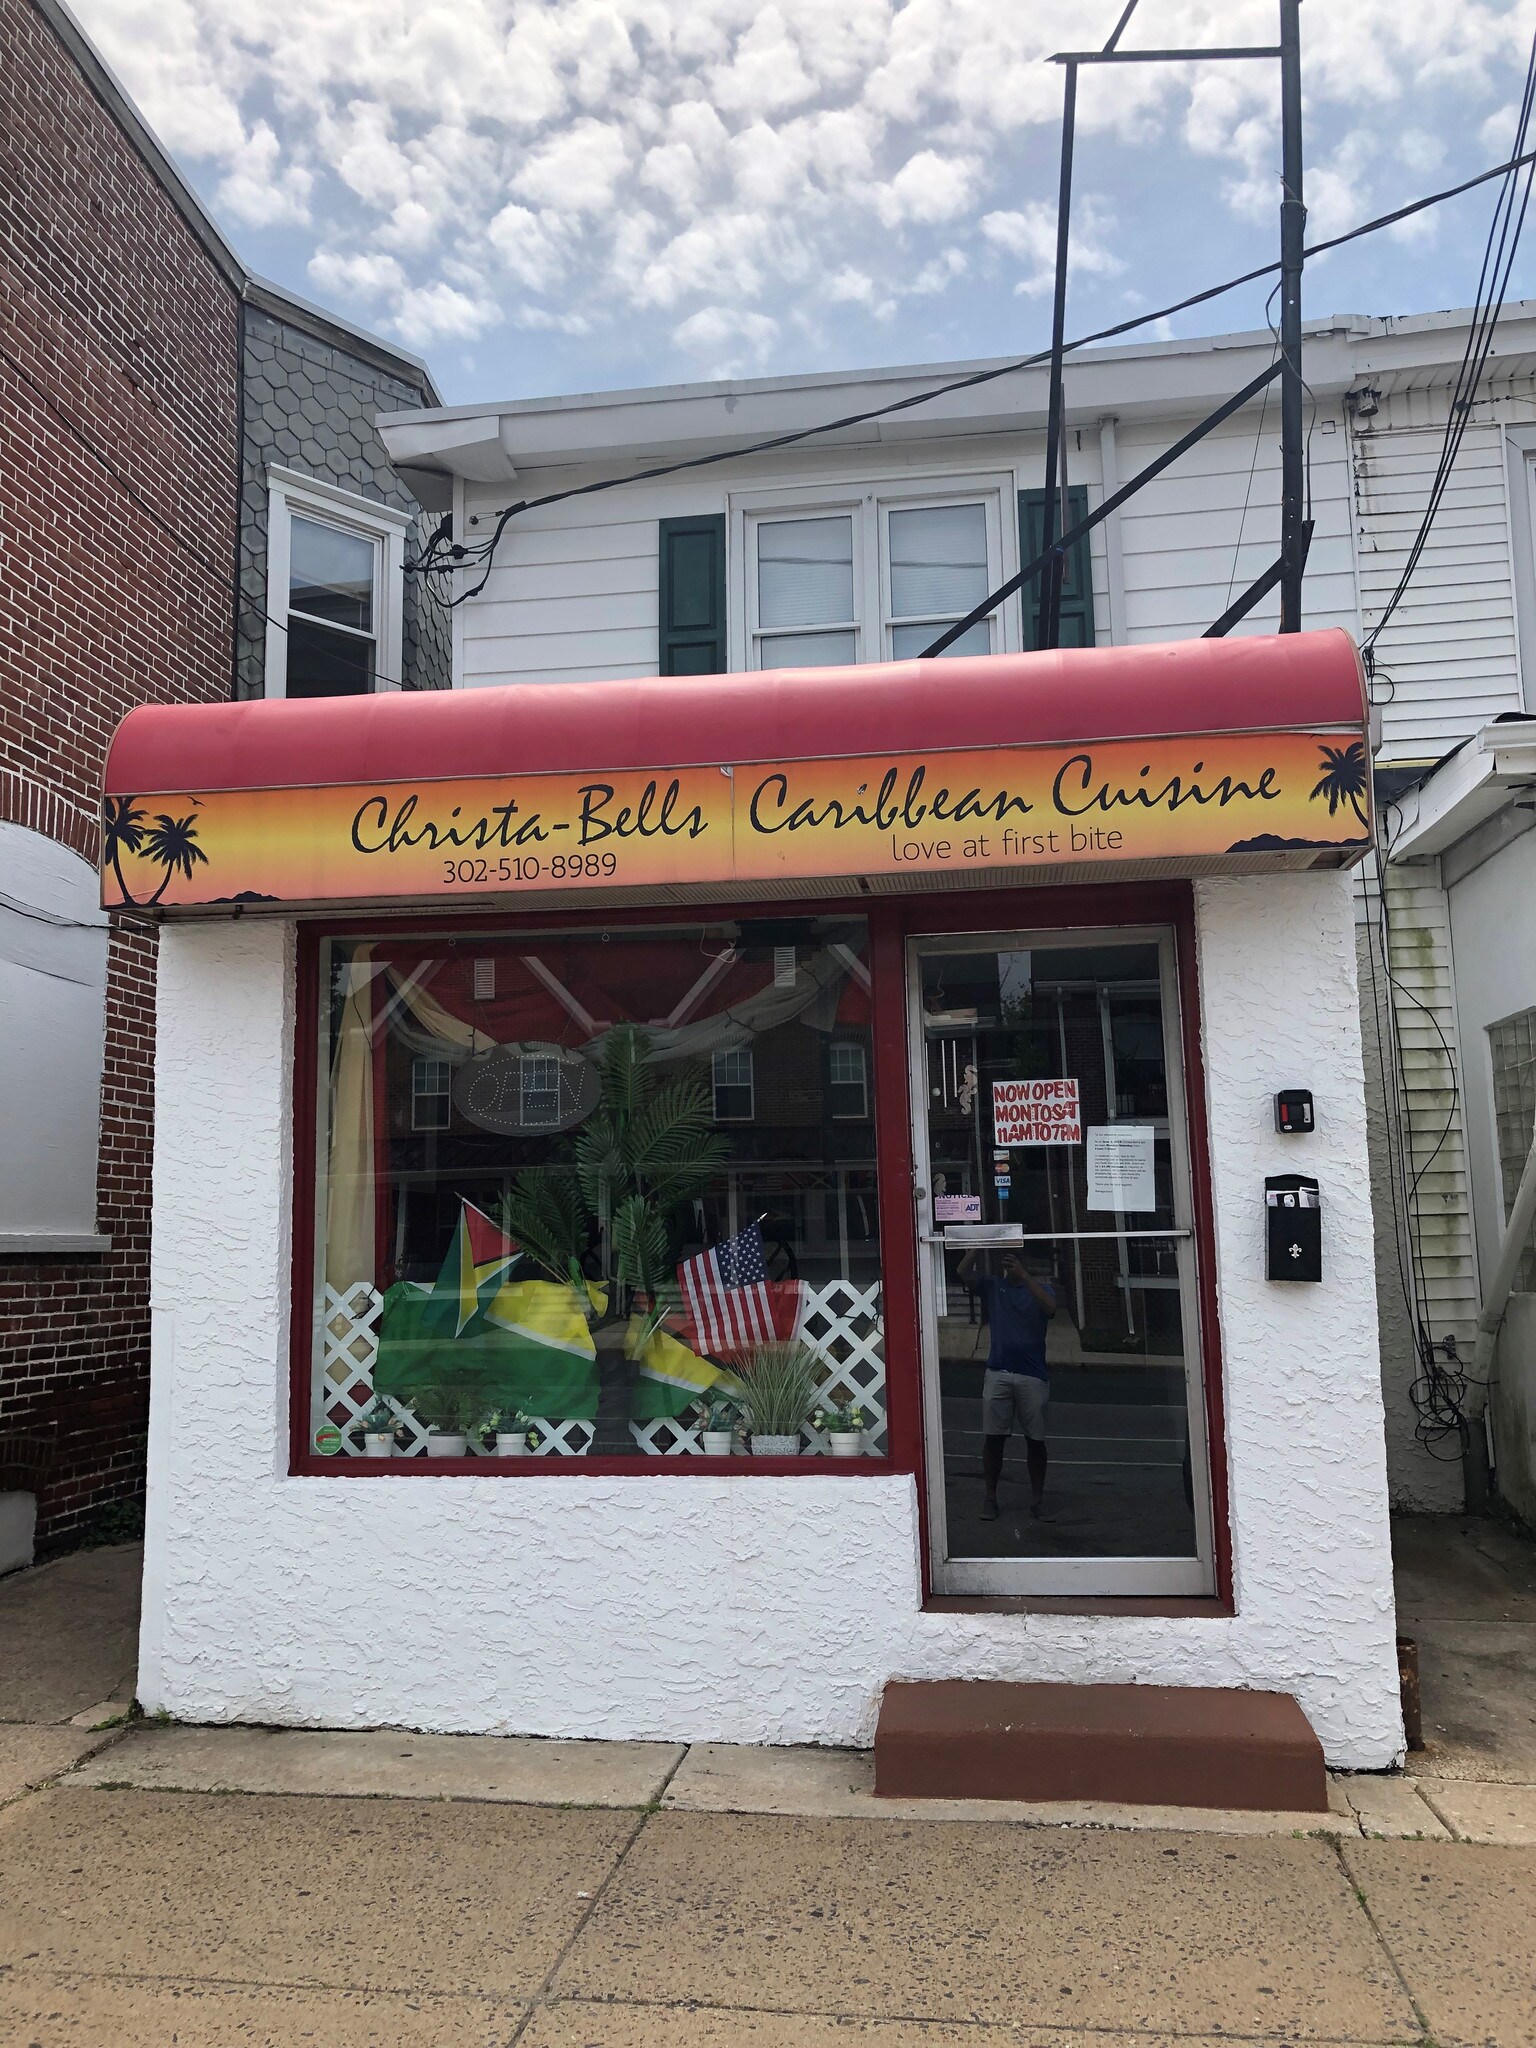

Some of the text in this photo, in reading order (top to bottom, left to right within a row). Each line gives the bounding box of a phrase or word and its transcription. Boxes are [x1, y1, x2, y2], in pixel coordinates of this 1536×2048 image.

[352, 754, 1282, 853] Christa-Bells Caribbean Cuisine
[892, 823, 1123, 861] love at first bite
[443, 852, 617, 884] 302-510-8989
[468, 1066, 586, 1112] OPEN
[993, 1080, 1076, 1103] NOW OPEN
[995, 1100, 1080, 1123] MON TO SAT
[1032, 1121, 1052, 1142] TO
[1051, 1123, 1080, 1142] 7PM
[965, 1203, 980, 1212] ADT
